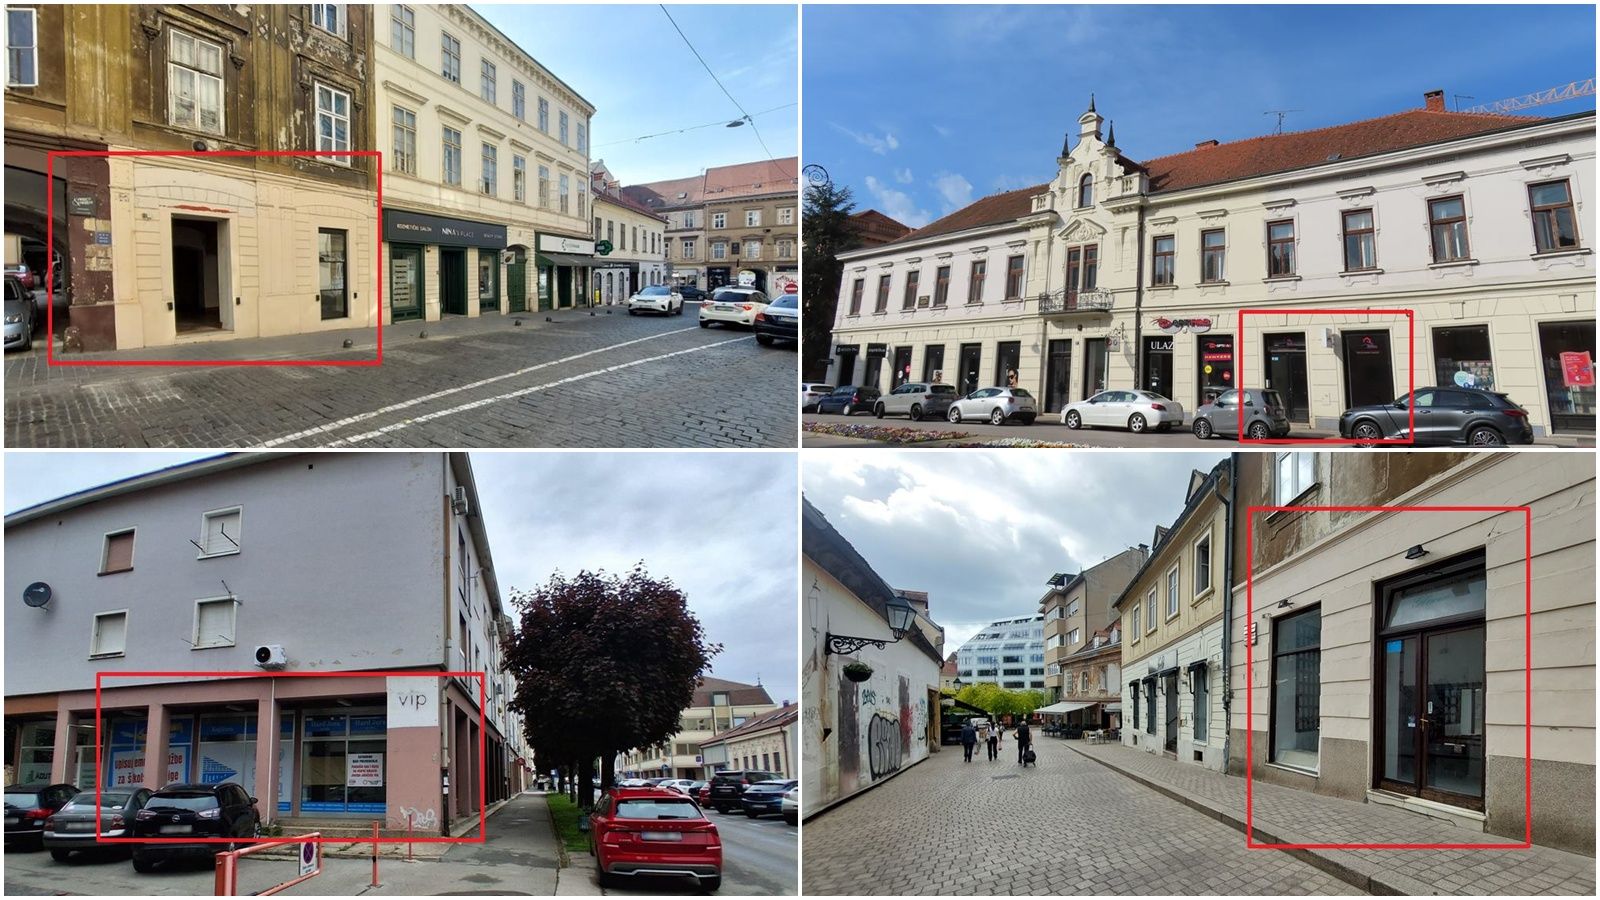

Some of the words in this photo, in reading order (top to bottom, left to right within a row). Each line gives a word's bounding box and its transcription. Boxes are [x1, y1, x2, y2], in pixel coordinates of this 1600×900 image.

[1150, 341, 1174, 350] ULAZ
[399, 691, 427, 711] vip
[114, 758, 146, 770] upisujem
